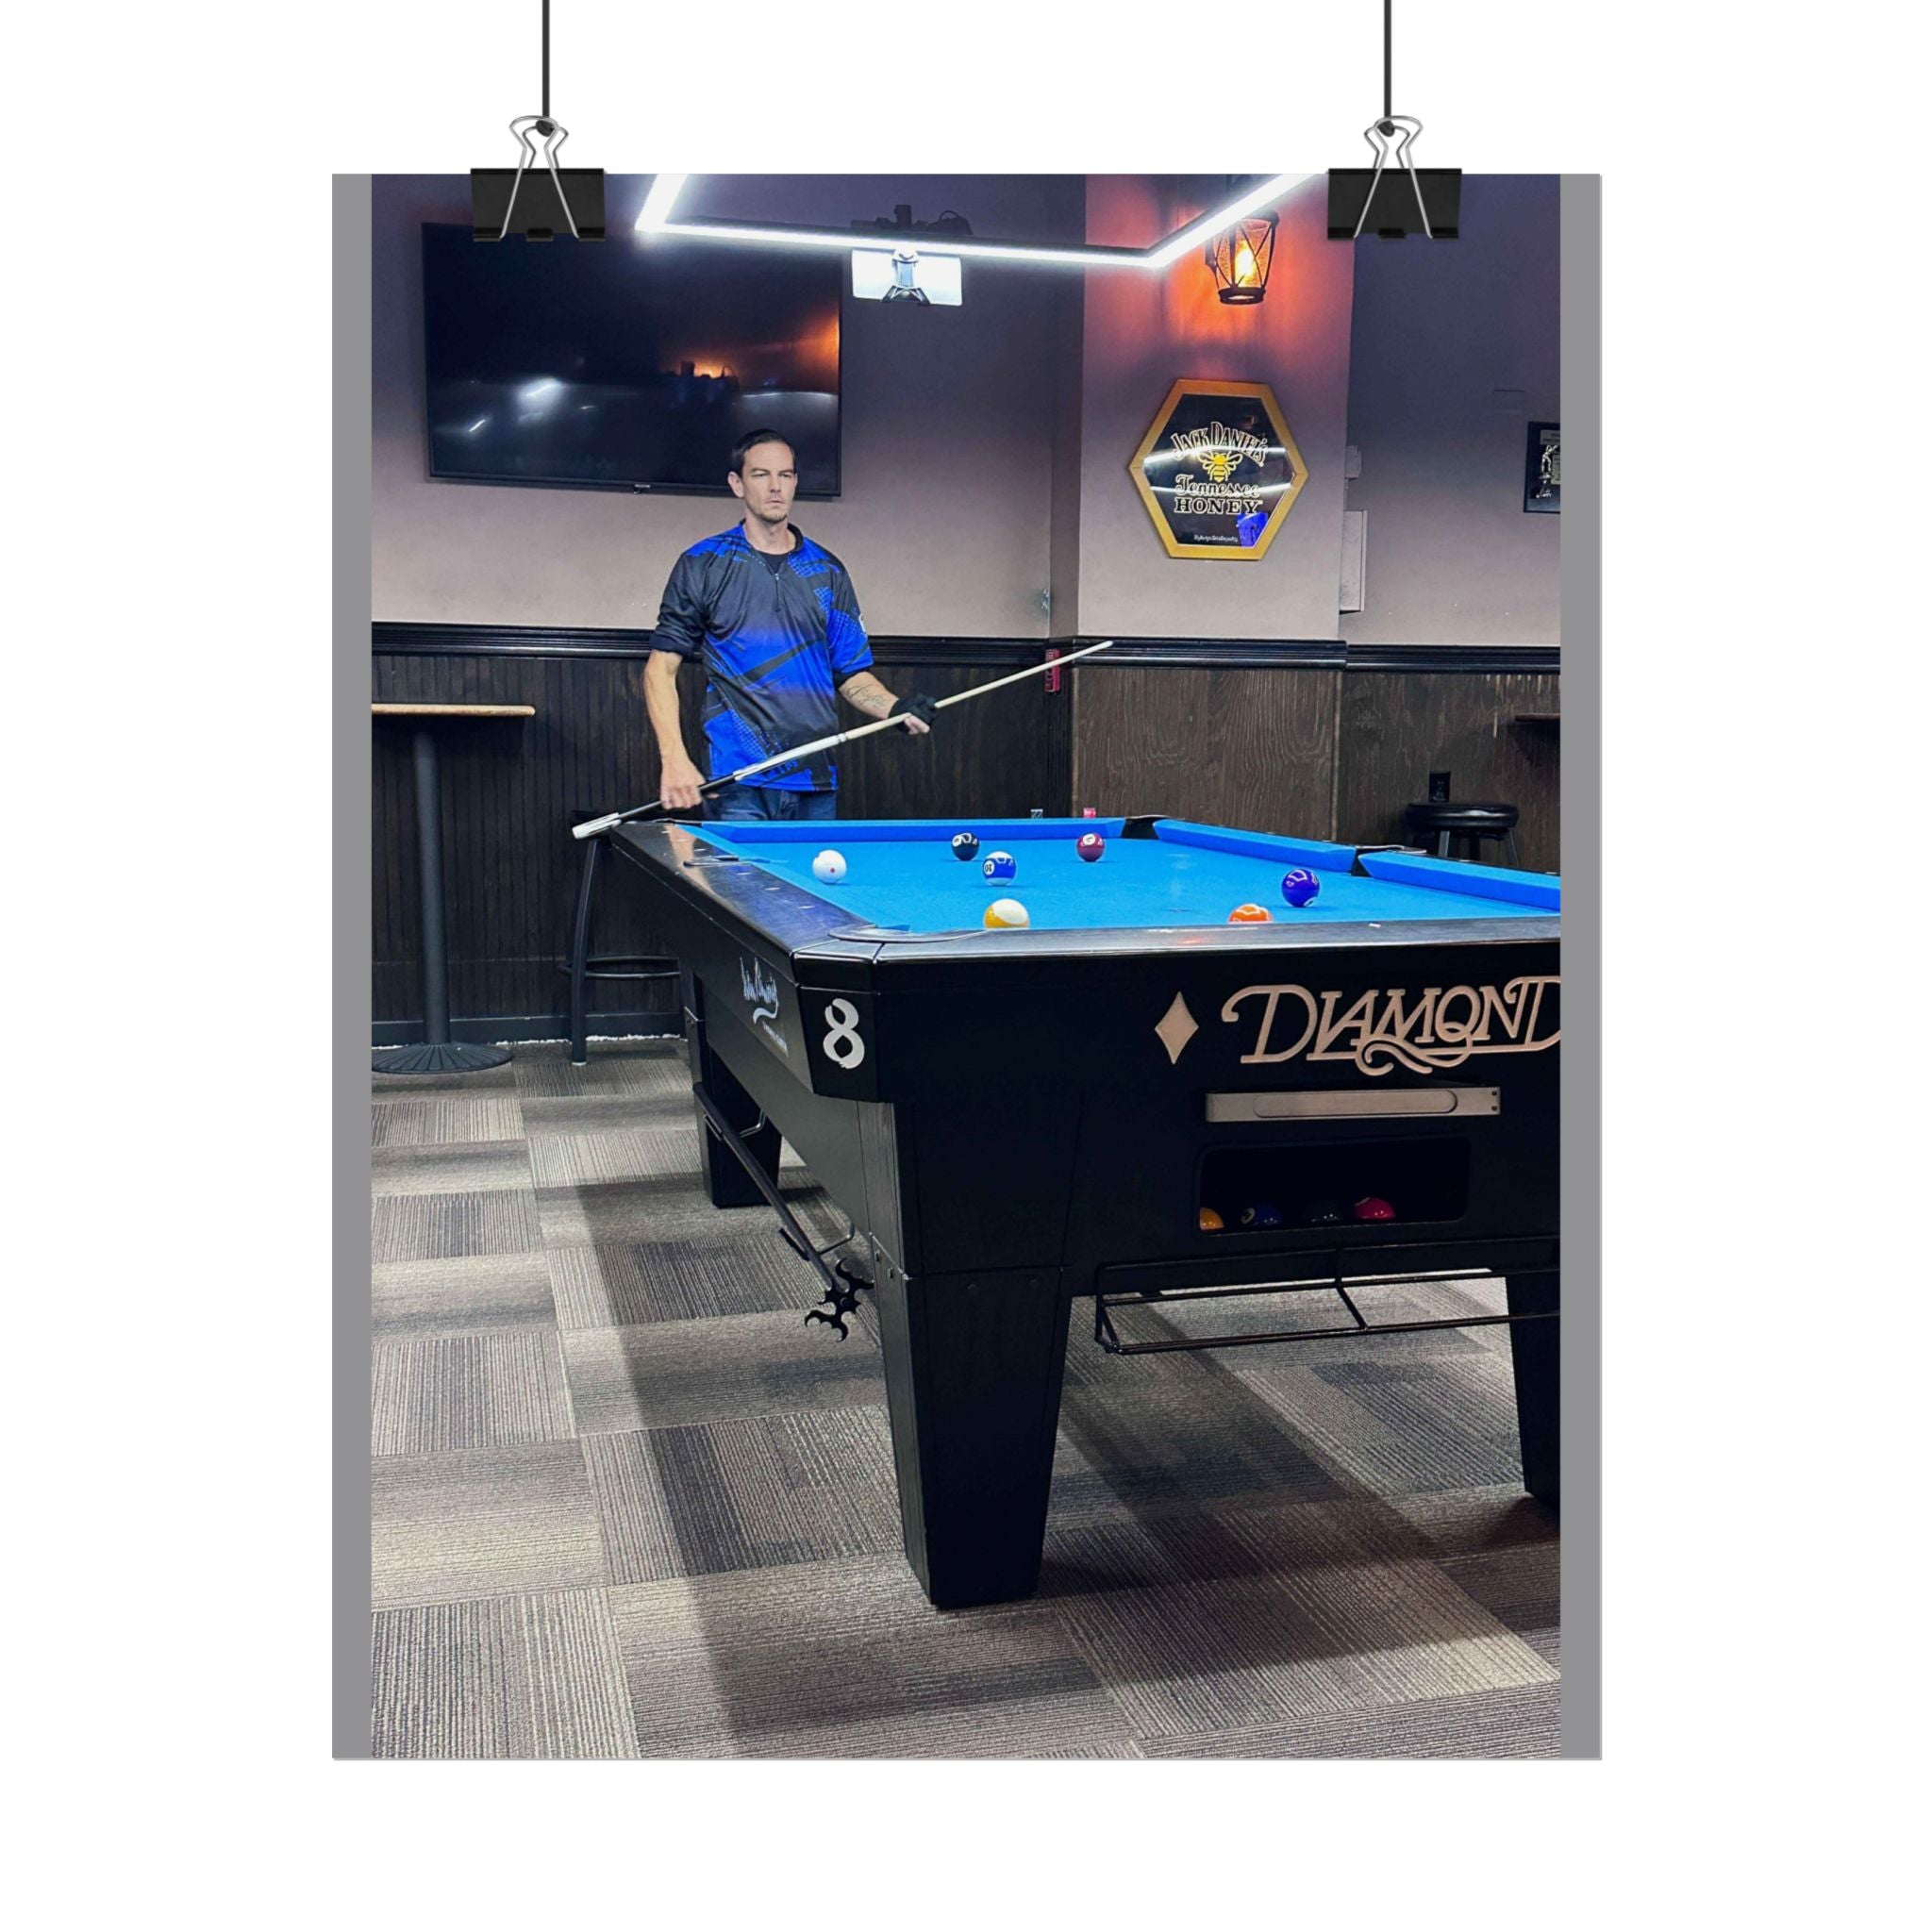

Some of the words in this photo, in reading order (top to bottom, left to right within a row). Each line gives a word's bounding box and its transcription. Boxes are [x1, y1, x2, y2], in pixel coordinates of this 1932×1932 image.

[1171, 427, 1209, 461] JACK
[1210, 421, 1268, 467] DANIEL'S
[1175, 474, 1260, 498] Tennessee
[1174, 497, 1263, 514] HONEY
[823, 998, 865, 1069] 8
